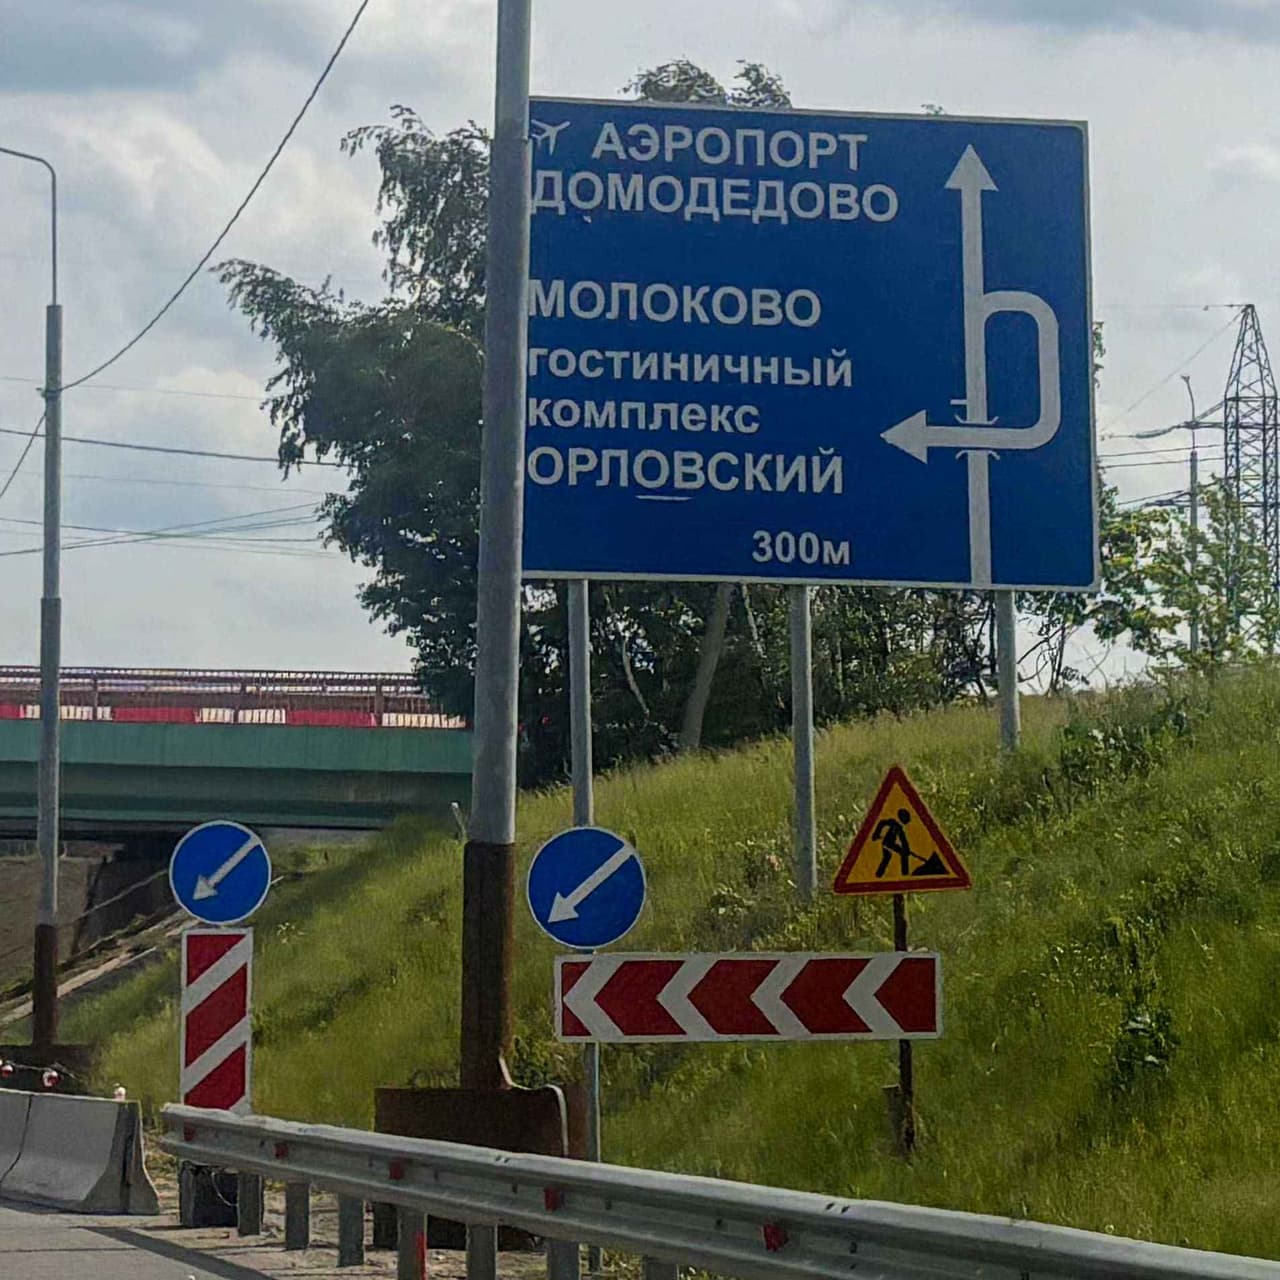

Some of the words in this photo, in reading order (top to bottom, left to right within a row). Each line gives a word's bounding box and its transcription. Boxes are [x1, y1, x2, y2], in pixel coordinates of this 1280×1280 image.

[591, 121, 868, 170] АЭРОПОРТ
[529, 170, 899, 224] ДОМОДЕДОВО
[528, 279, 821, 328] МОЛОКОВО
[528, 347, 853, 387] гостиничный
[528, 397, 760, 434] комплекс
[527, 445, 844, 495] ОРЛОВСКИЙ
[752, 530, 851, 566] 300м
